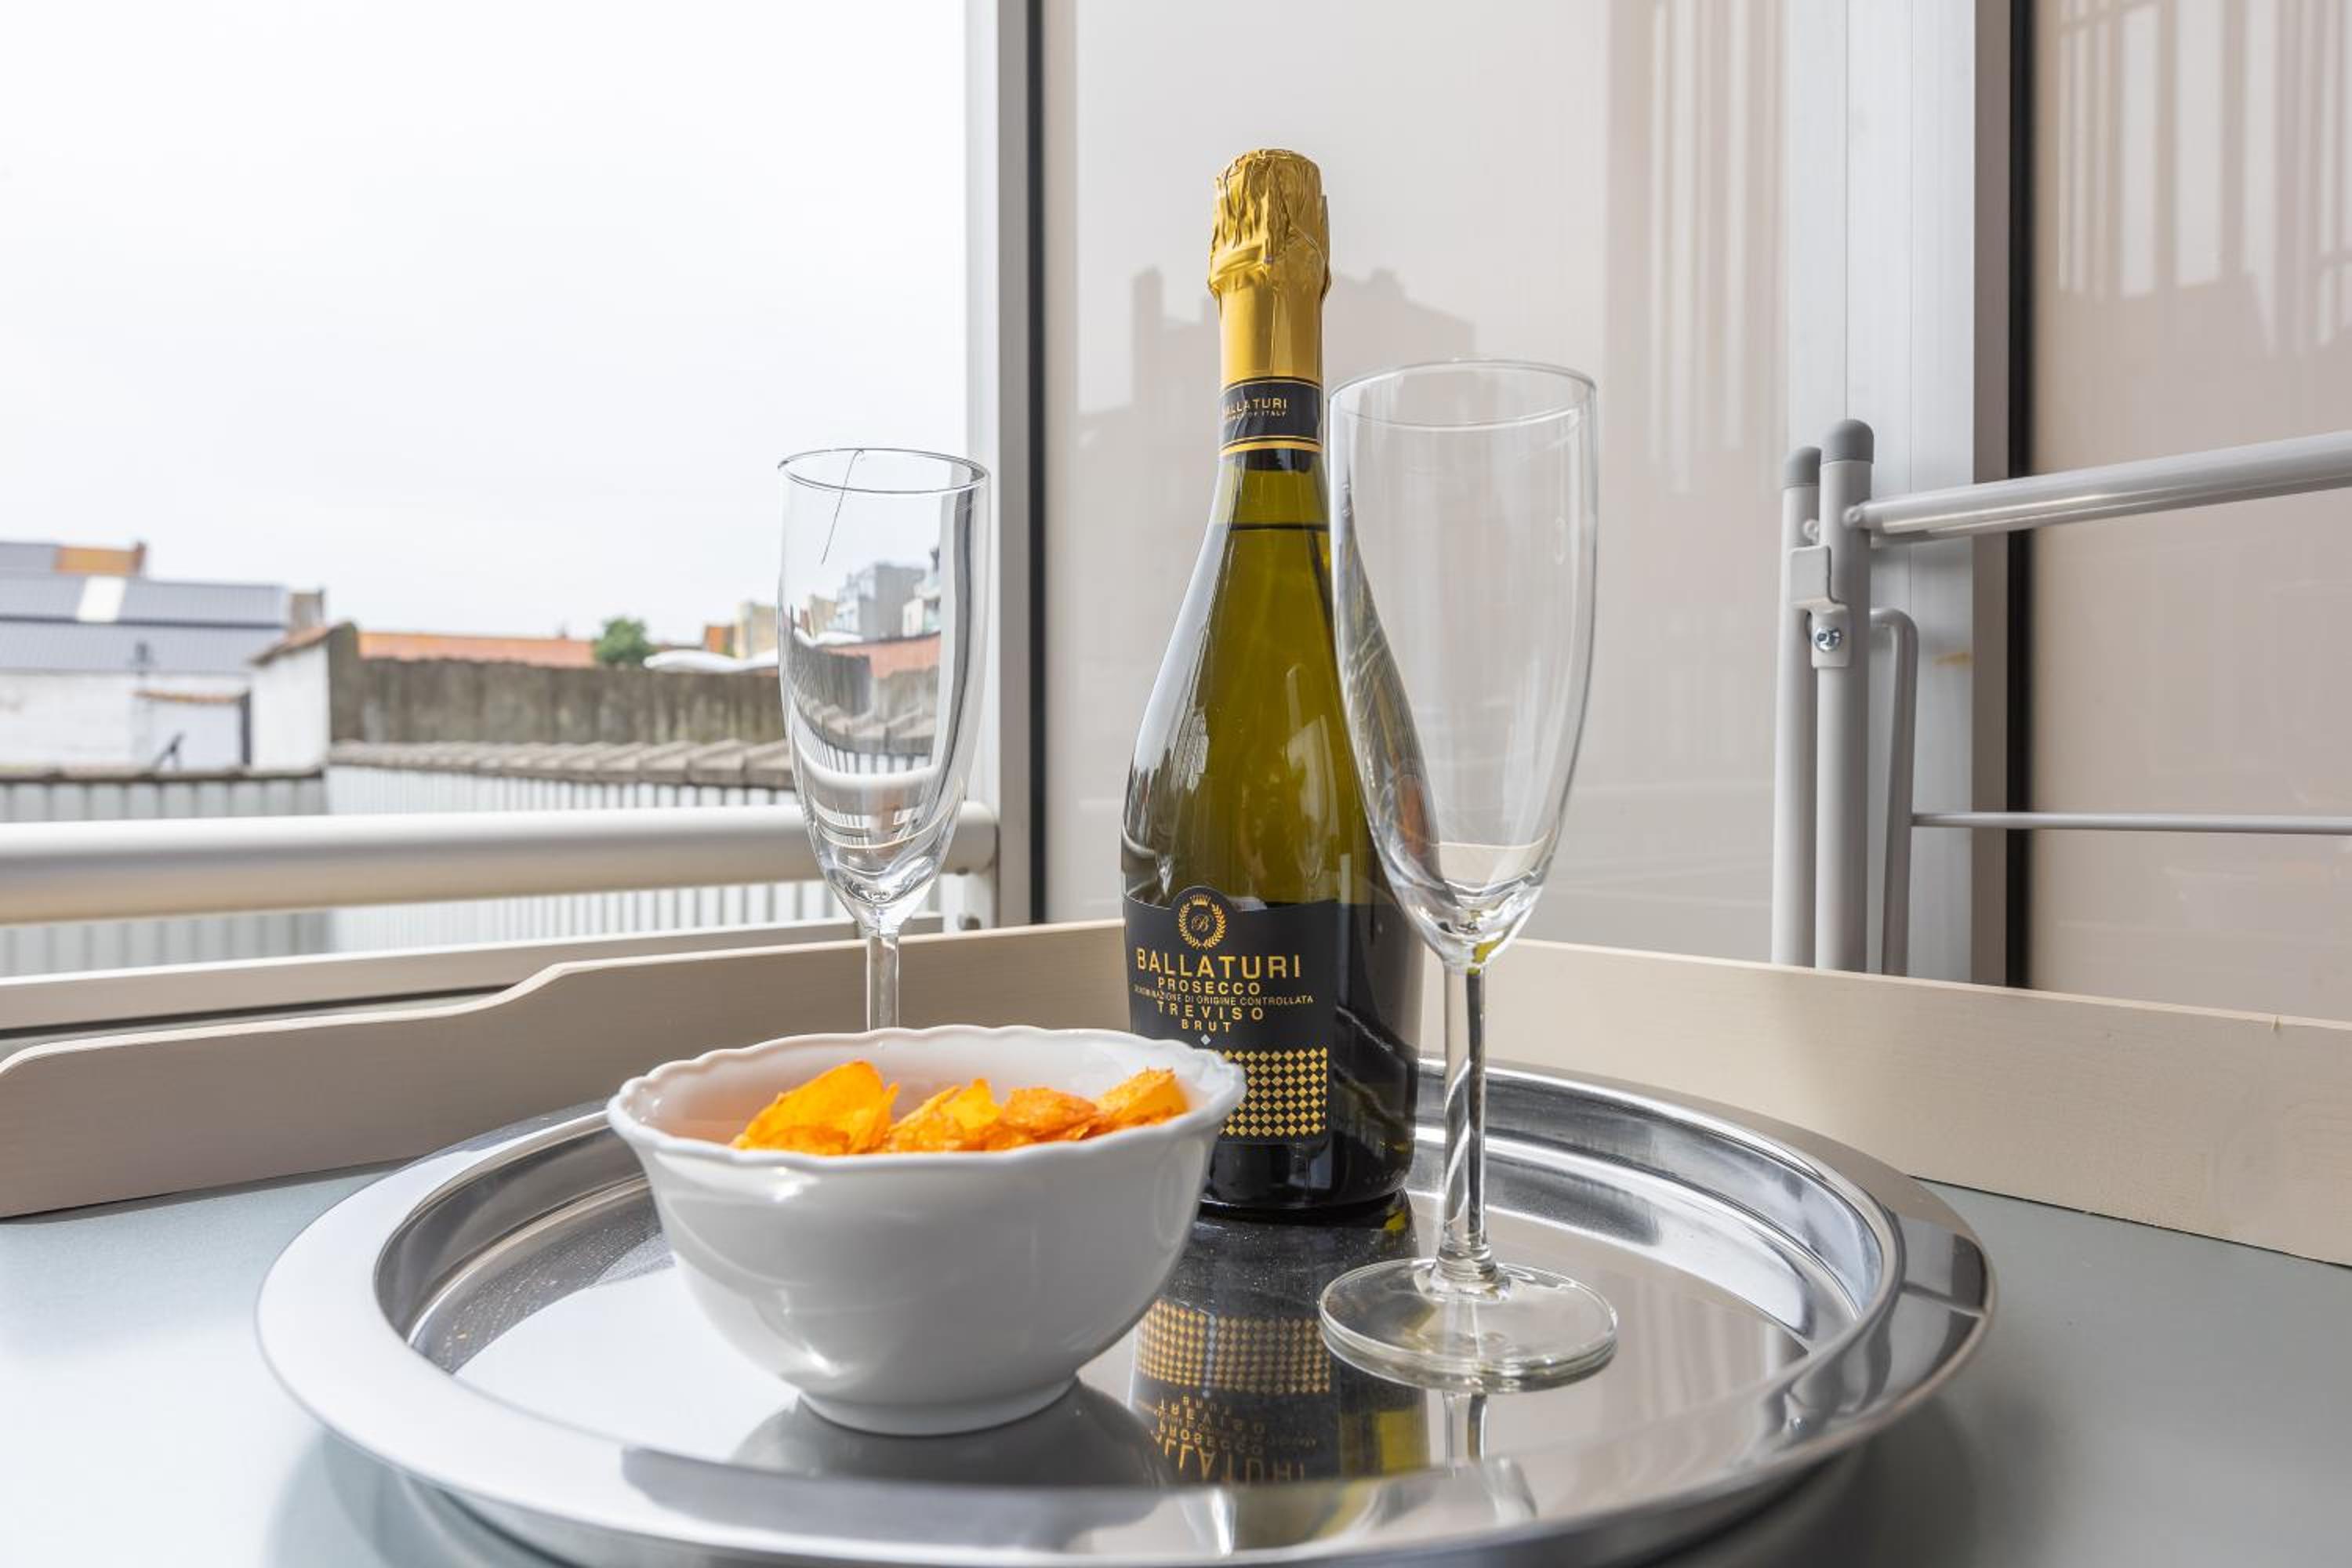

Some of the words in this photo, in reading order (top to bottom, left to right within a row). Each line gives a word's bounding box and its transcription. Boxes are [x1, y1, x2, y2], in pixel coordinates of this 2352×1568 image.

[1221, 397, 1287, 413] LLATURI
[1137, 947, 1301, 979] BALLATURI
[1158, 977, 1261, 995] PROSECCO
[1196, 996, 1236, 1006] ORIGINE
[1240, 995, 1314, 1006] CONTROLLATA
[1157, 1000, 1264, 1021] TREVISO
[1181, 1019, 1232, 1033] BRUT
